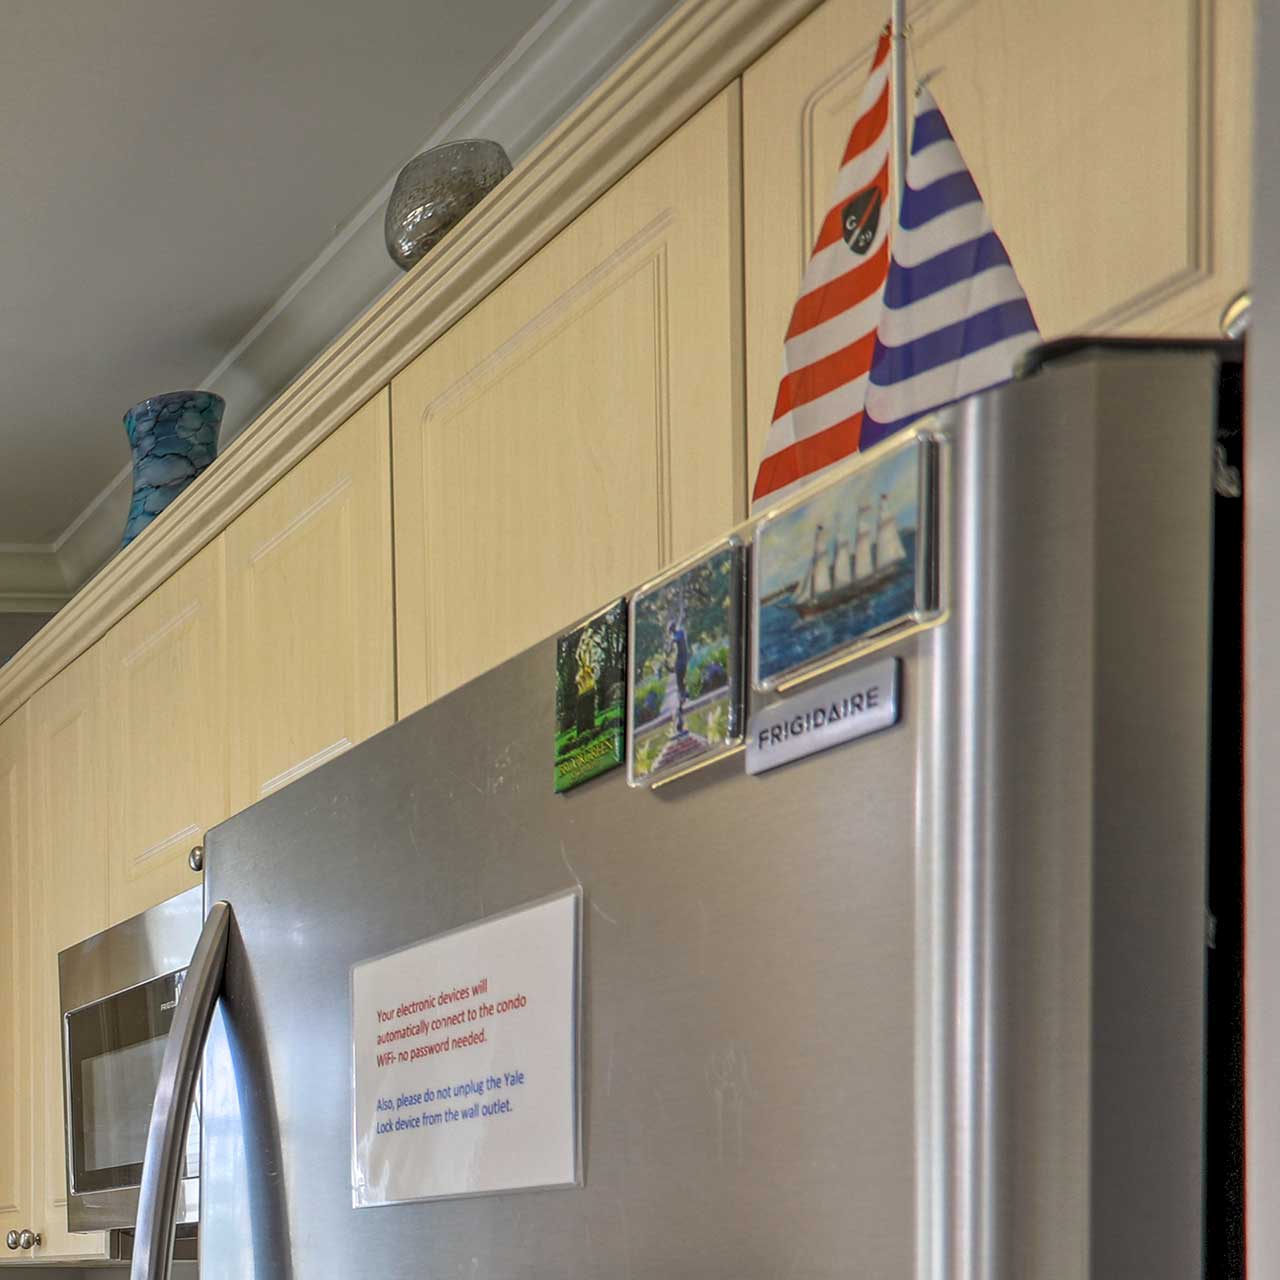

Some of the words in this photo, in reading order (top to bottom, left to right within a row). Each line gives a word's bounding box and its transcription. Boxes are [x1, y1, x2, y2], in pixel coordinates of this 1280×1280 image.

[757, 685, 880, 750] FRIGIDAIRE
[376, 1008, 395, 1023] Your
[395, 995, 437, 1018] electronic
[437, 988, 470, 1006] devices
[471, 978, 488, 996] will
[376, 1019, 430, 1046] automatically
[431, 1011, 465, 1031] connect
[467, 1008, 478, 1022] to
[479, 1003, 495, 1018] the
[496, 993, 527, 1013] condo
[397, 1051, 409, 1063] no
[410, 1037, 450, 1063] password
[451, 1028, 488, 1051] needed.
[376, 1098, 395, 1112] Also,
[396, 1092, 422, 1112] please
[423, 1088, 436, 1103] do
[436, 1085, 452, 1099] not
[453, 1080, 485, 1098] unplug
[486, 1075, 502, 1091] the
[503, 1070, 525, 1086] Yale
[376, 1118, 394, 1135] Lock
[395, 1115, 420, 1131] device
[422, 1112, 443, 1126] from
[444, 1107, 459, 1123] the
[461, 1103, 480, 1119] wall
[481, 1099, 513, 1117] outlet.
